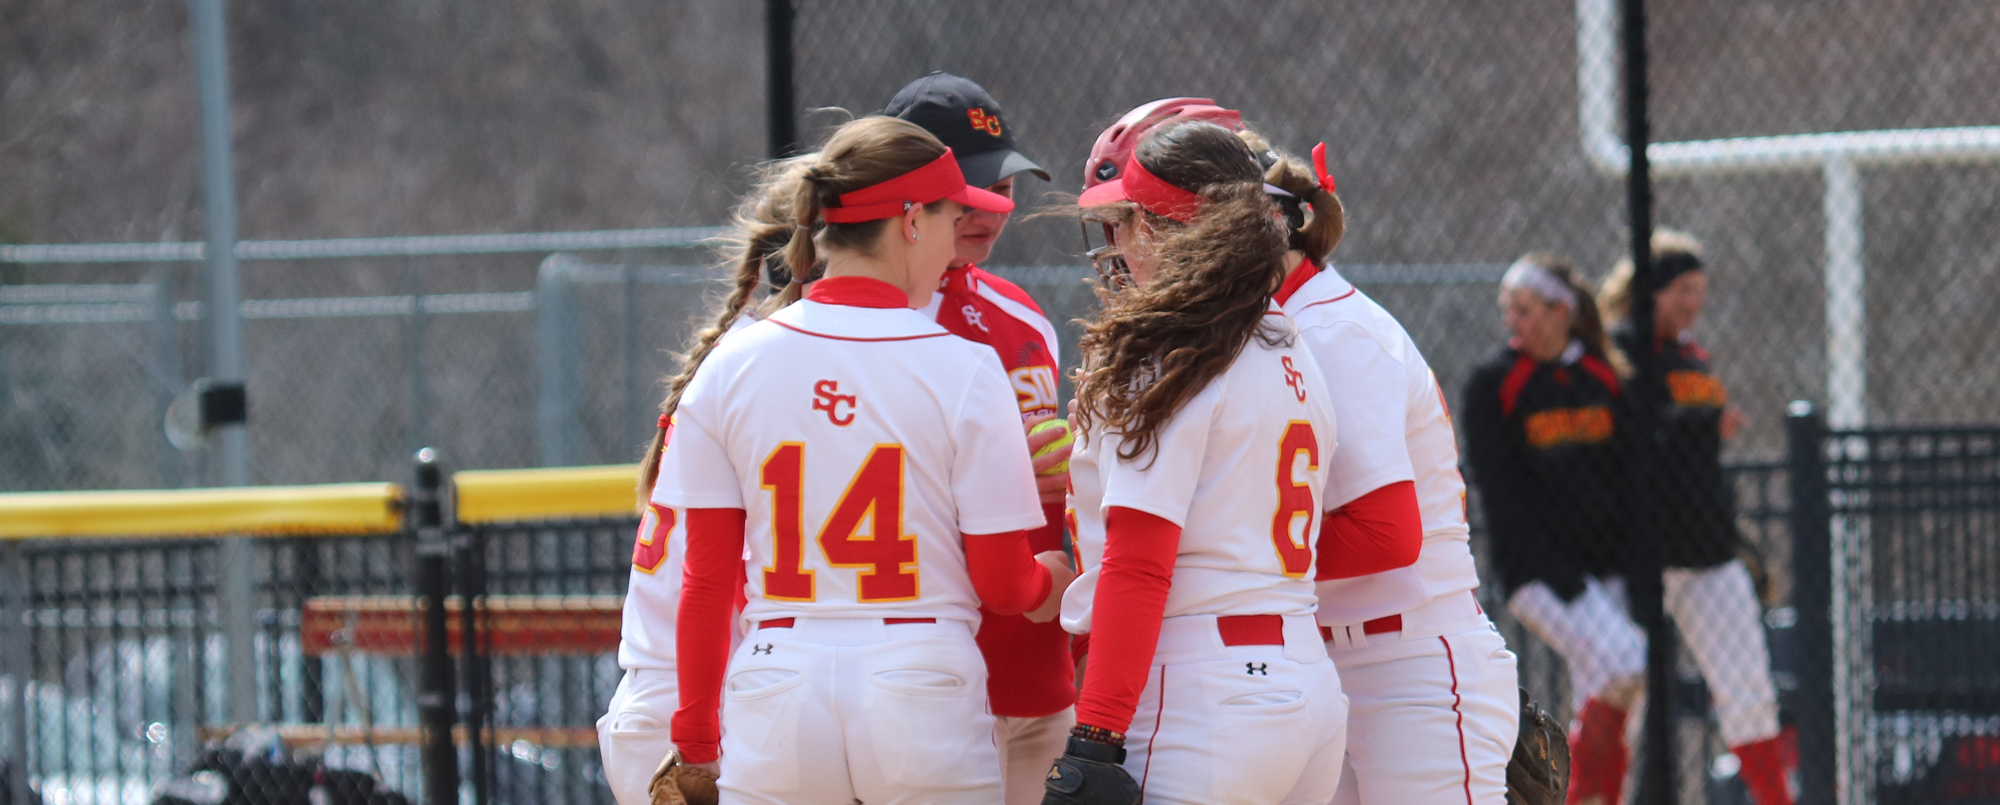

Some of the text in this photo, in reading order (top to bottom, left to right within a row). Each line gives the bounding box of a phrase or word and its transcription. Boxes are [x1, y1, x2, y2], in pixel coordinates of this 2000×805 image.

[967, 107, 1001, 136] SC
[812, 379, 856, 427] SC
[1281, 355, 1306, 404] SC
[759, 441, 920, 604] 14
[1271, 419, 1319, 579] 6
